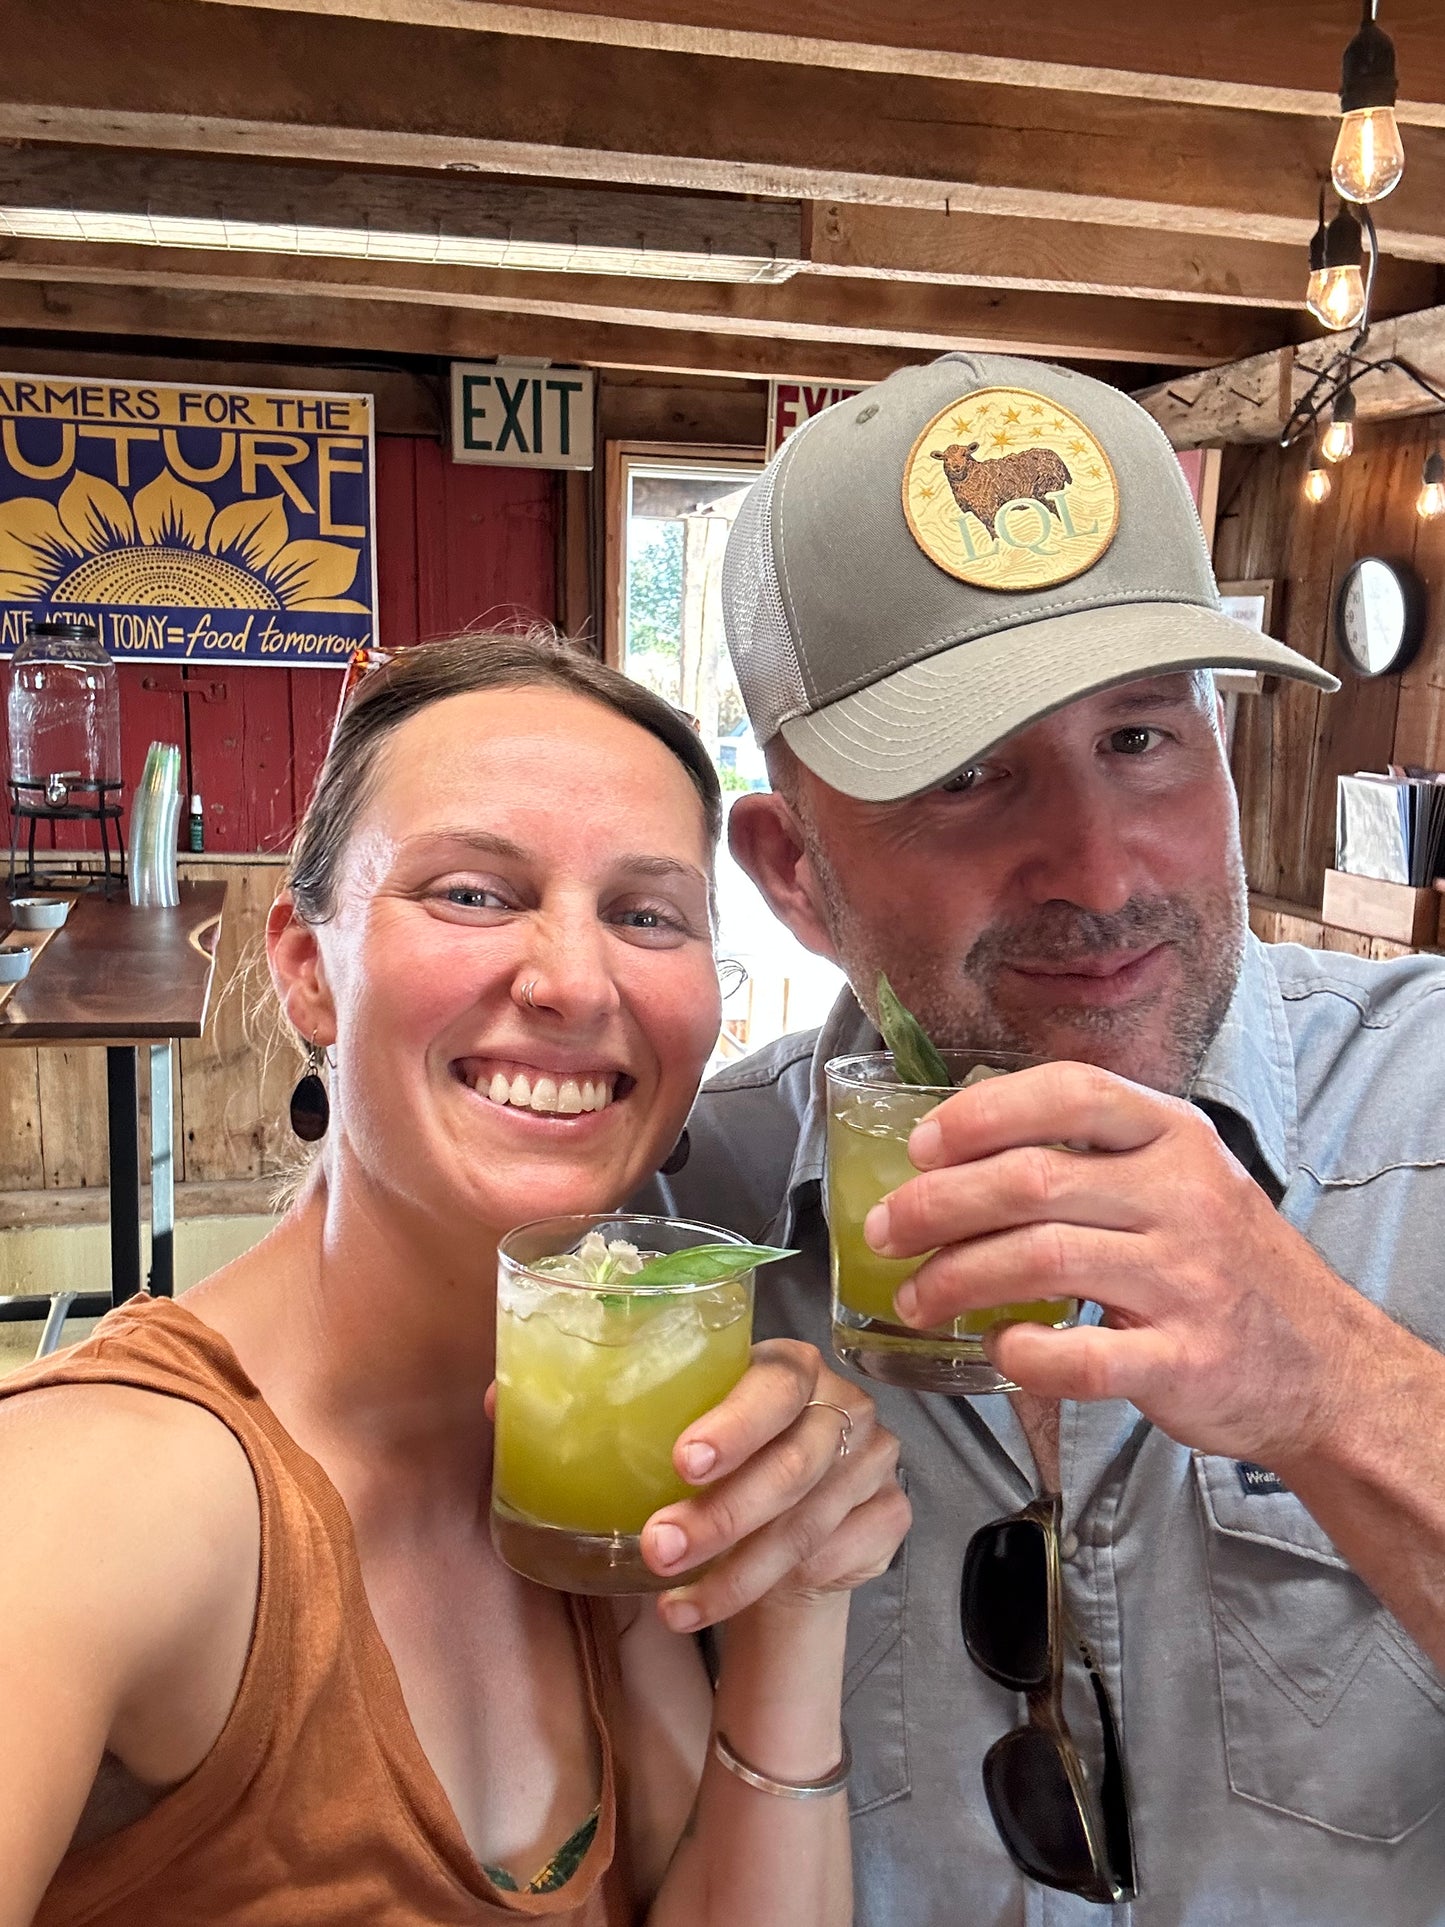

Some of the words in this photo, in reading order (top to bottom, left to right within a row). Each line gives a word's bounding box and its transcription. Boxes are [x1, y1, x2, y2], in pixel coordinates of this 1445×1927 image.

[179, 393, 255, 424] FOR
[266, 398, 350, 430] THE
[463, 375, 583, 455] EXIT
[951, 489, 1099, 564] LQL
[258, 616, 371, 654] tomorrow
[1245, 1471, 1281, 1484] Wran
